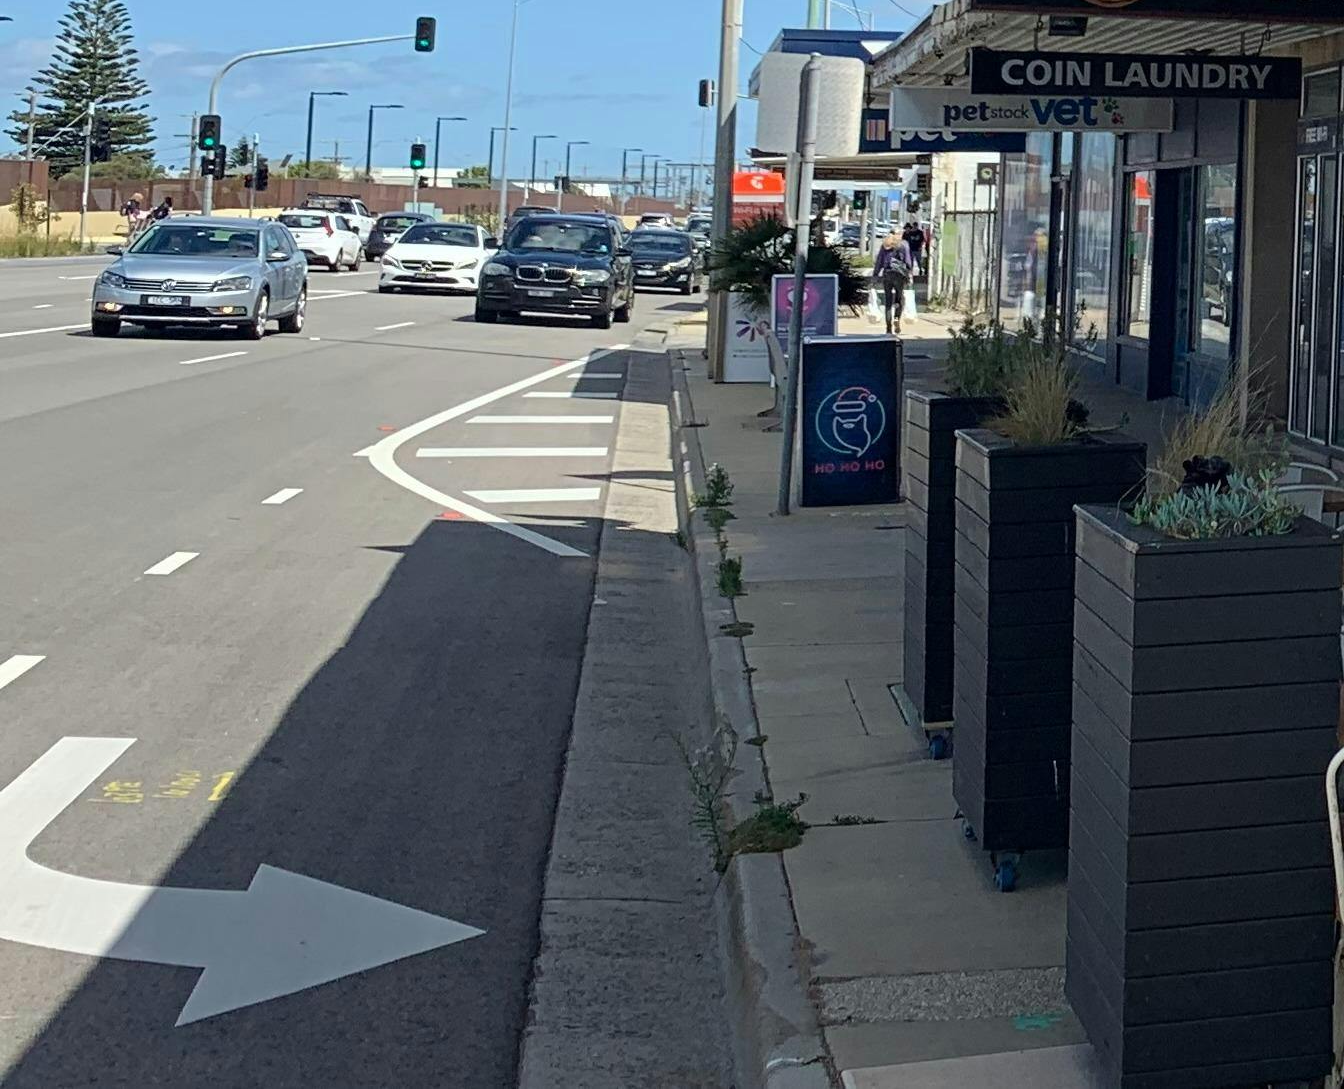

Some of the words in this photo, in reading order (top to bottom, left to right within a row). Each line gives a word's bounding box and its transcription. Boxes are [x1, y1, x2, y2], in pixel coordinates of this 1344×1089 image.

[1000, 58, 1091, 86] COIN
[1104, 61, 1272, 90] LAUNDRY
[1030, 96, 1098, 126] vet
[814, 463, 835, 474] HO
[840, 461, 861, 472] HO
[865, 460, 885, 470] HO
